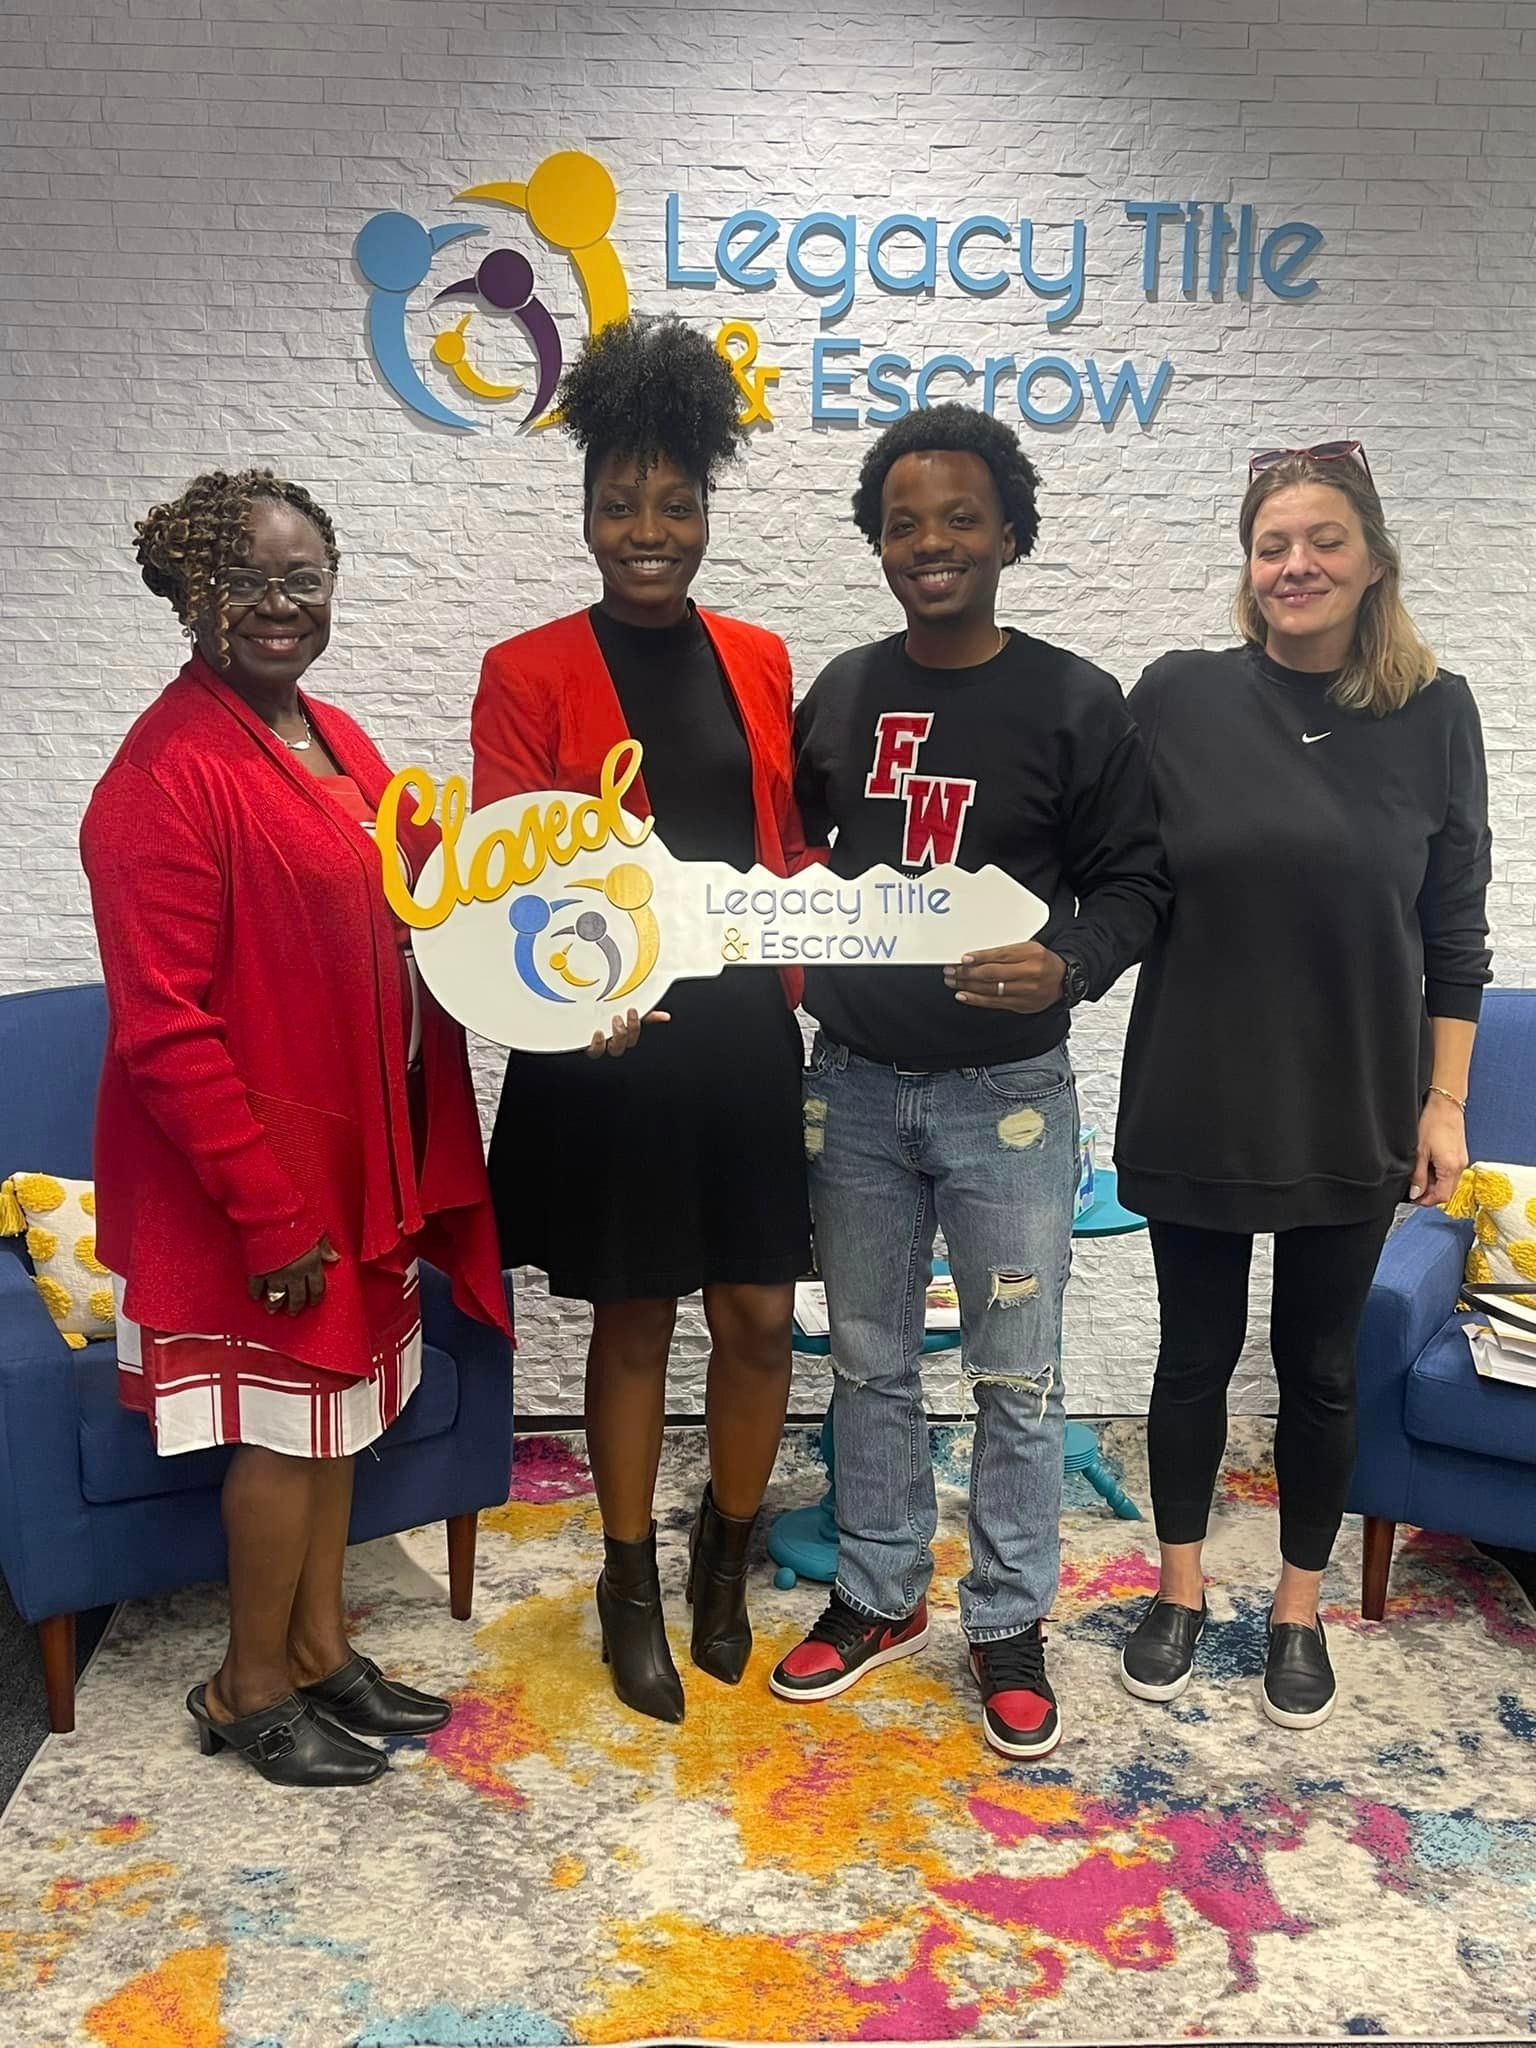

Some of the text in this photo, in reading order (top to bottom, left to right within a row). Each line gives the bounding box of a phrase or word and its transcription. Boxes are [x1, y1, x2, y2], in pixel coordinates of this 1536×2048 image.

[666, 192, 1325, 325] Legacy Title
[716, 319, 1171, 426] & Escrow
[376, 739, 656, 930] Closed
[706, 882, 951, 925] Legacy Title
[720, 927, 898, 962] & Escrow
